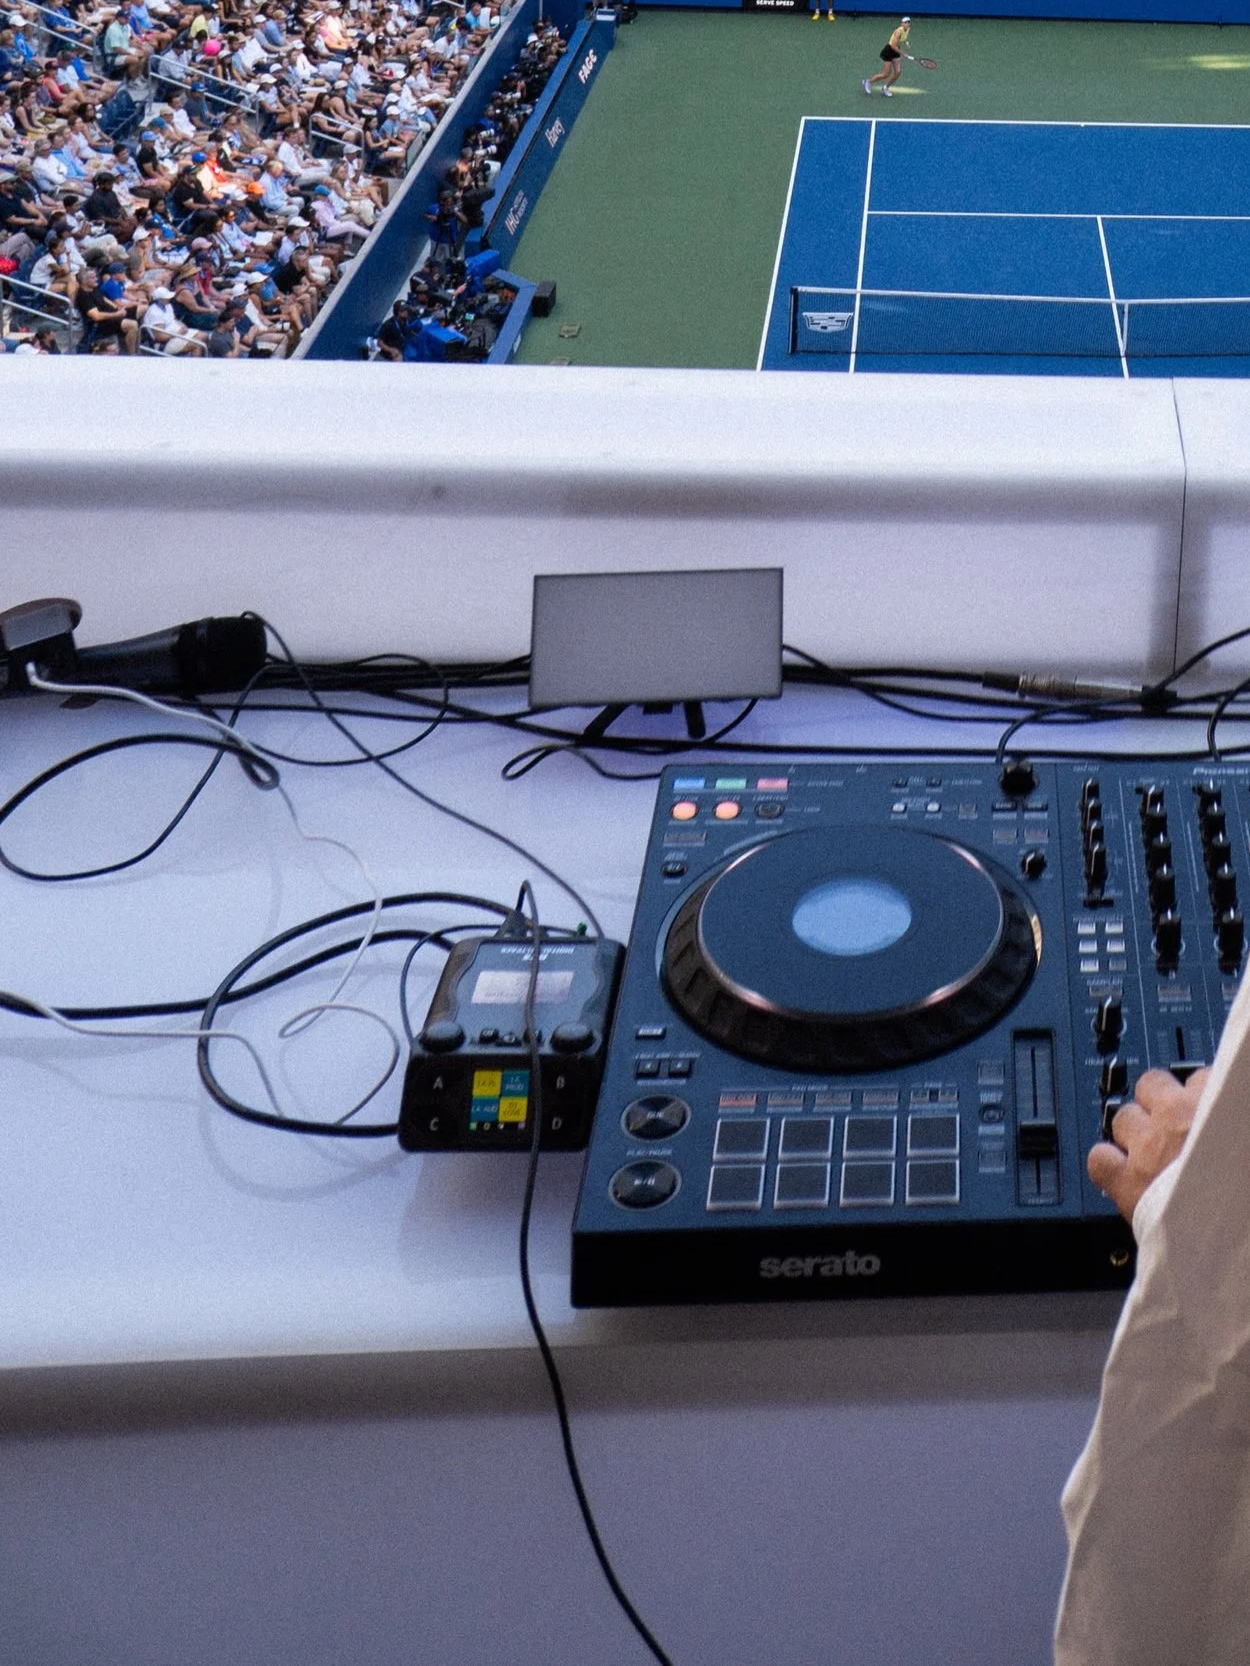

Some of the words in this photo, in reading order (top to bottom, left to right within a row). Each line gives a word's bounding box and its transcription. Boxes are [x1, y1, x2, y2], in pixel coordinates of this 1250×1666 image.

[433, 1076, 444, 1090] A
[555, 1076, 565, 1089] B
[429, 1117, 439, 1131] C
[551, 1117, 562, 1130] D
[759, 1249, 881, 1278] serato
